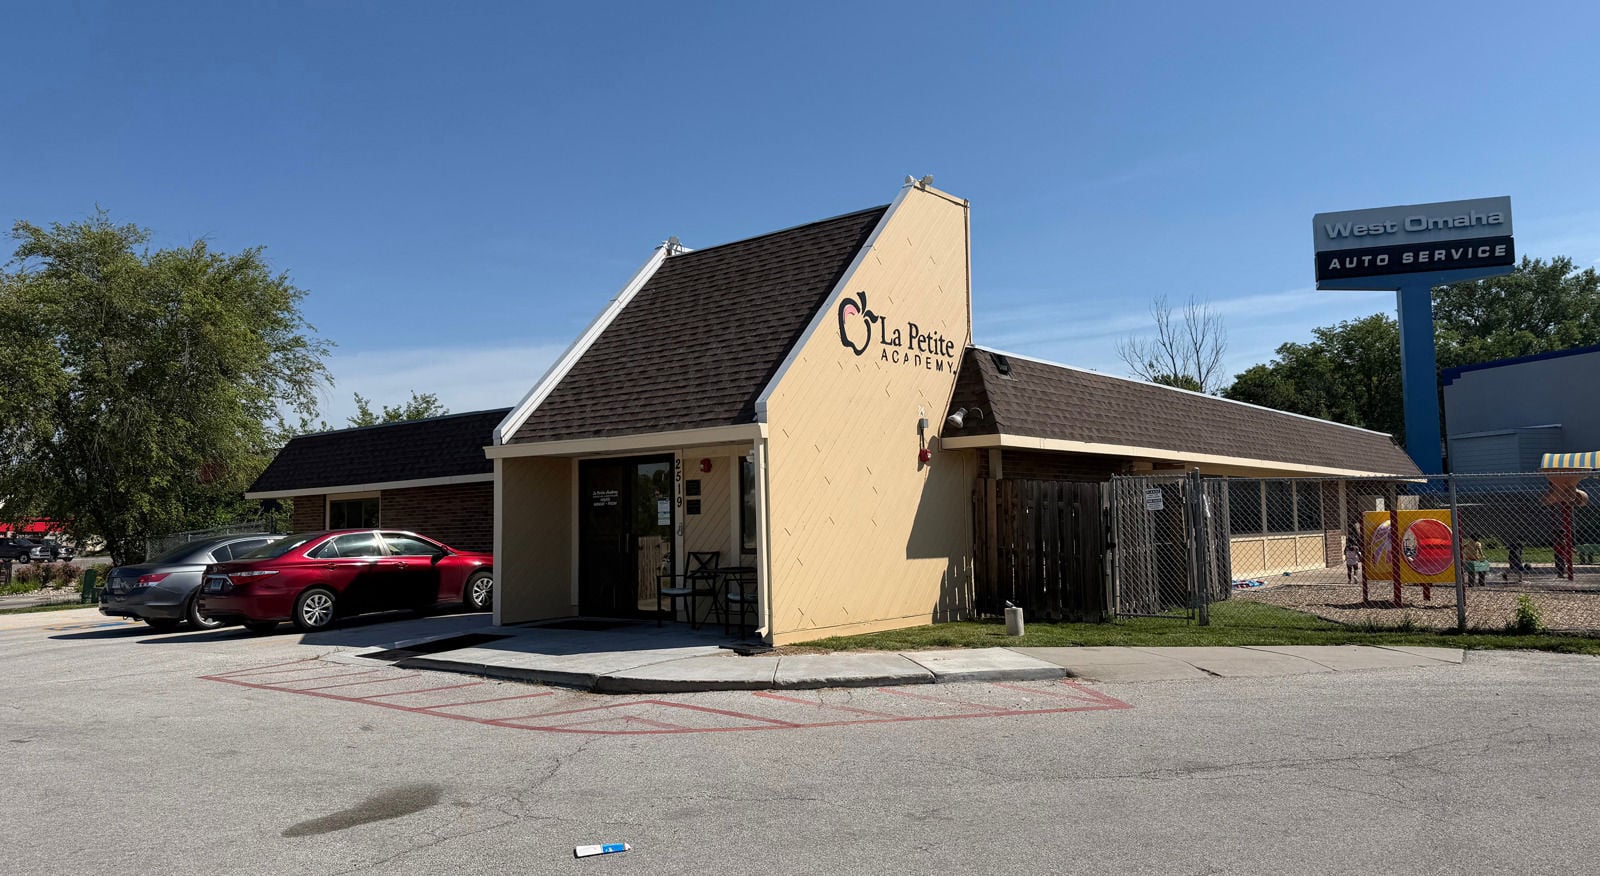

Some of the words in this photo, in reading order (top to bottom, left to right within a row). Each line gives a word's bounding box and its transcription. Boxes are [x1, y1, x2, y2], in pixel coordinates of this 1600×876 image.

[1325, 220, 1398, 239] West
[1404, 210, 1504, 232] Omaha
[1329, 254, 1389, 270] AUTO
[1402, 245, 1506, 264] SERVICE
[880, 316, 902, 347] La
[908, 321, 955, 358] Petite
